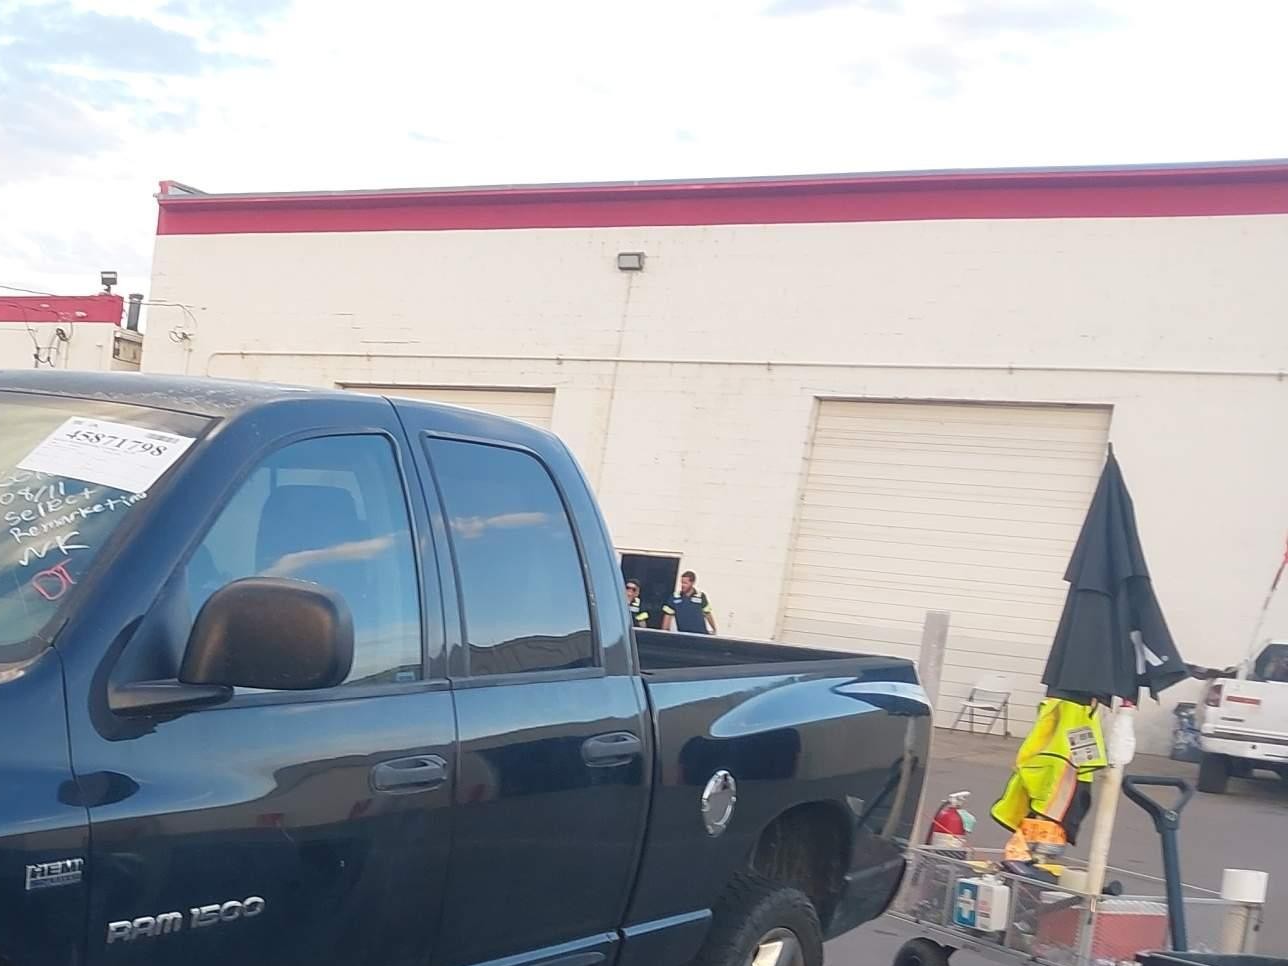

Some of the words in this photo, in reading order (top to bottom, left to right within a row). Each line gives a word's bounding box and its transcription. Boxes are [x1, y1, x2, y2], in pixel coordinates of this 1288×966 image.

[66, 429, 168, 457] 45871798
[106, 911, 183, 943] RAM
[190, 896, 265, 929] 1500
